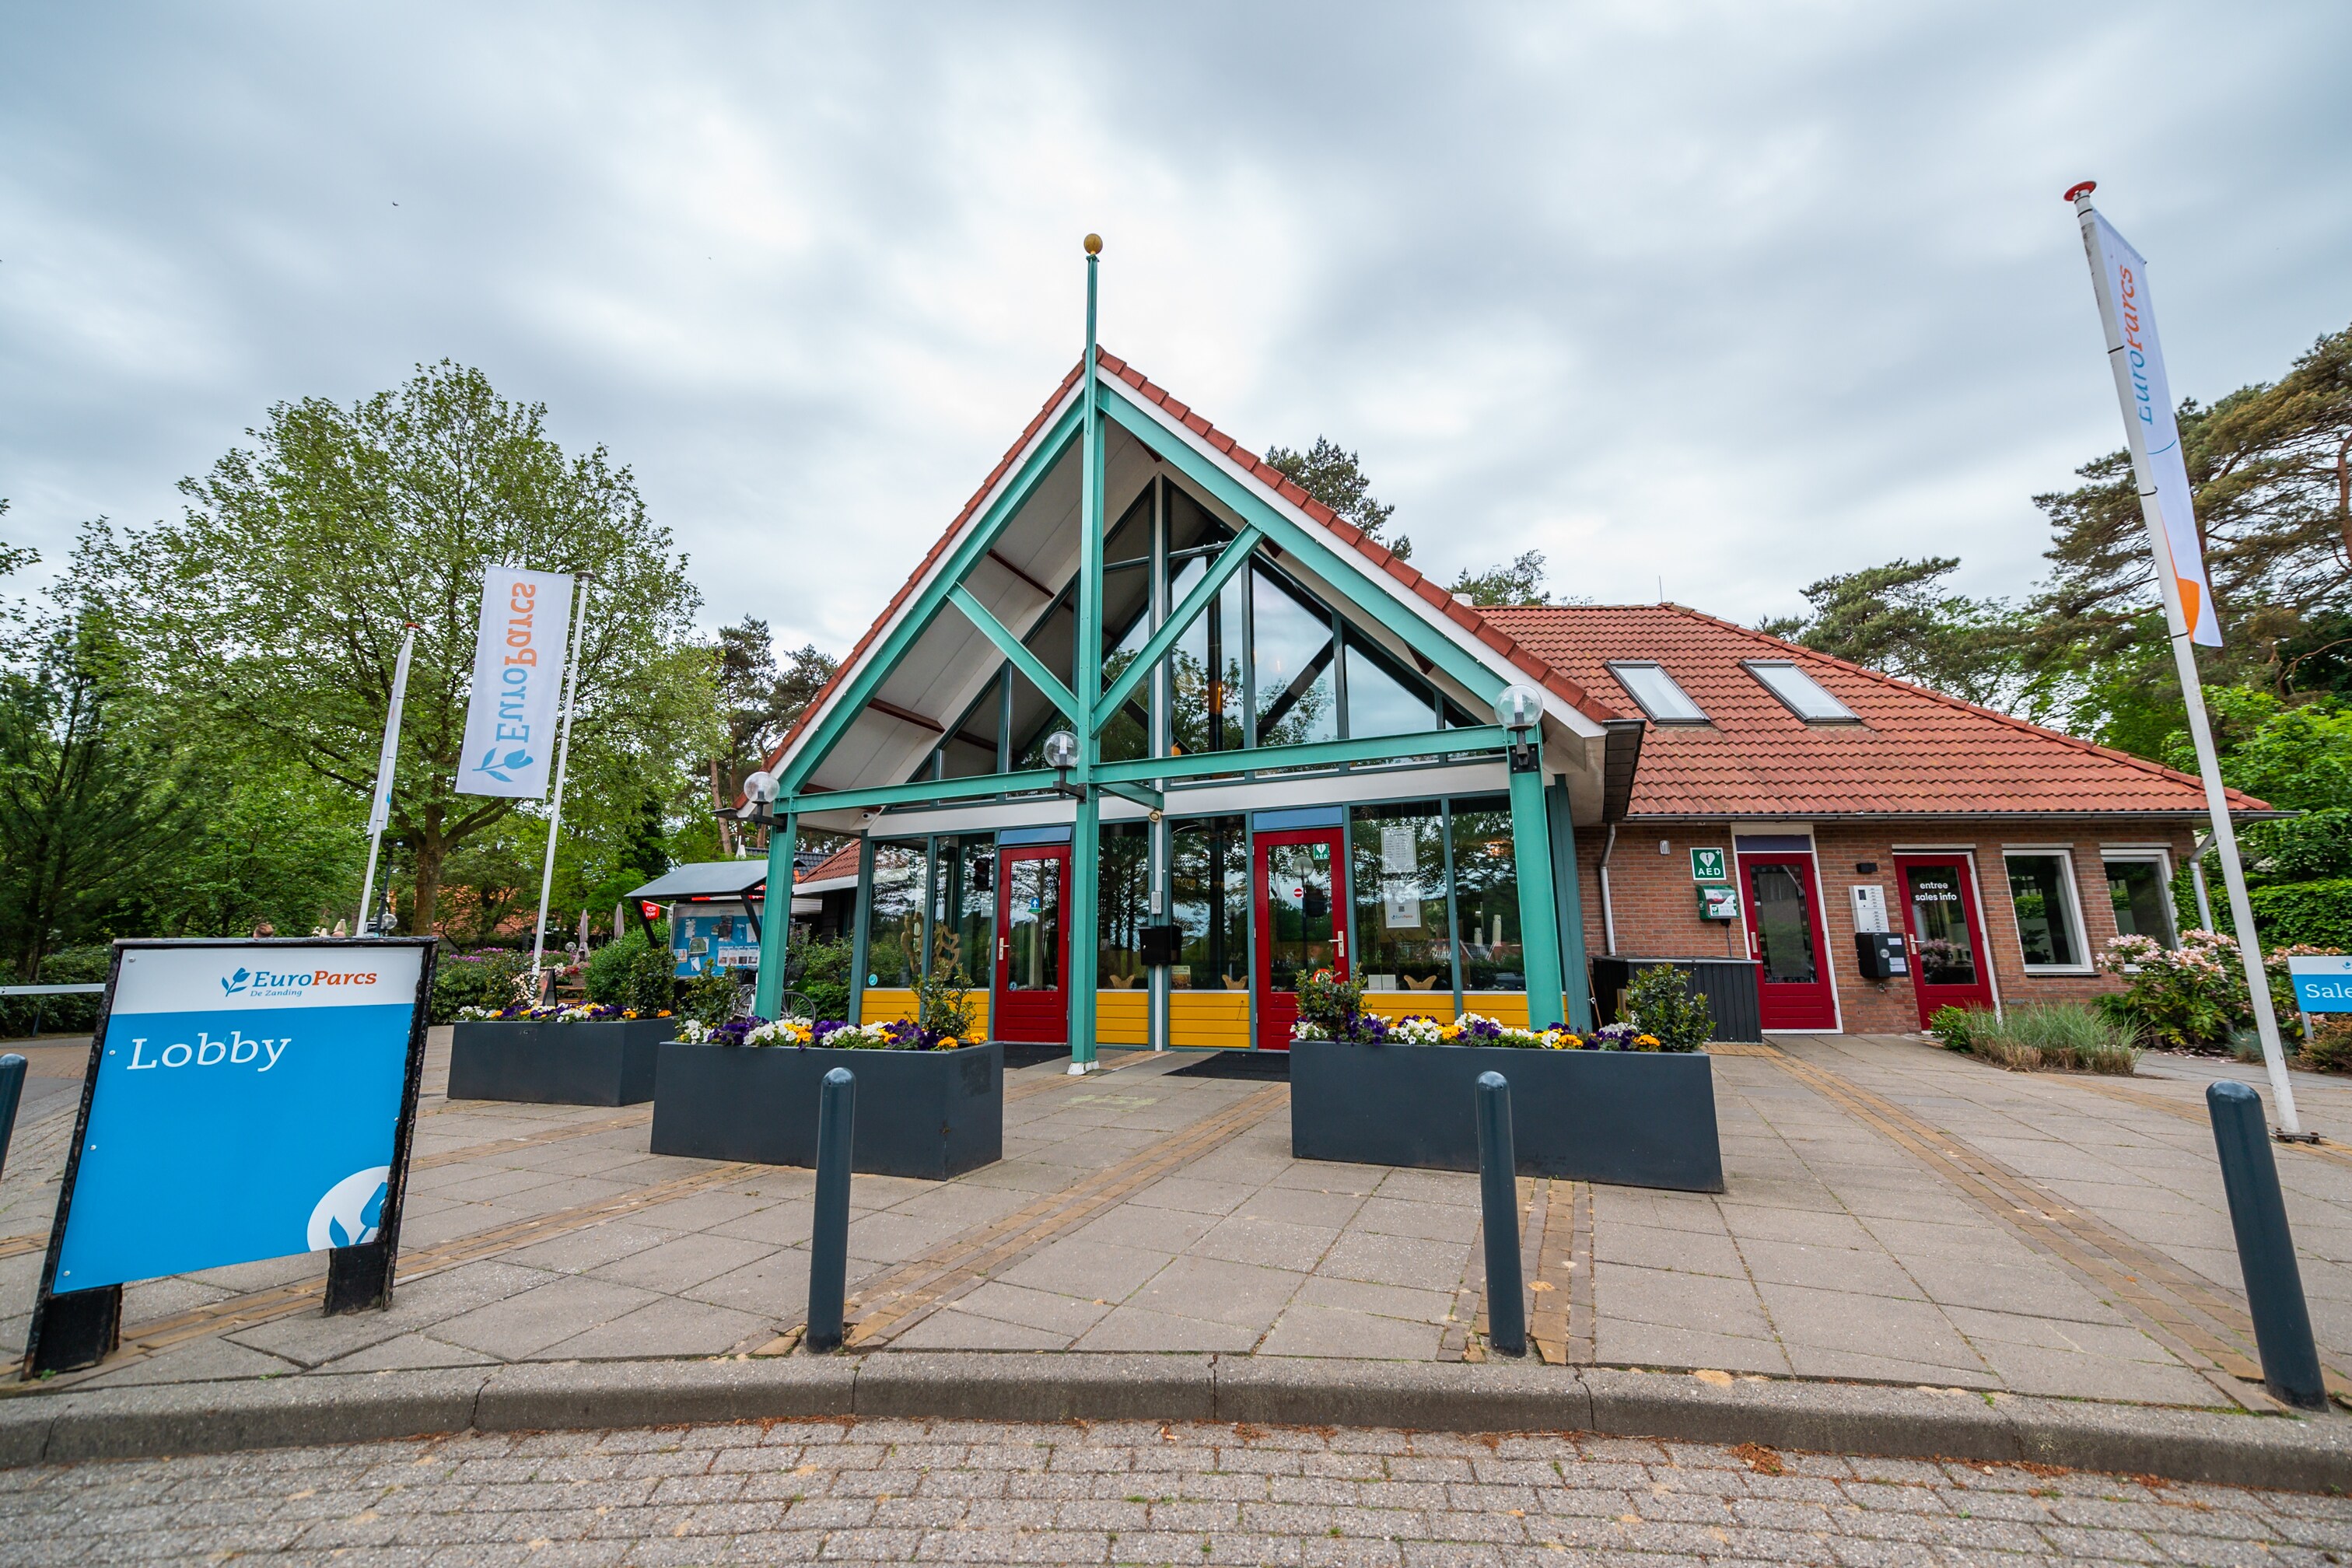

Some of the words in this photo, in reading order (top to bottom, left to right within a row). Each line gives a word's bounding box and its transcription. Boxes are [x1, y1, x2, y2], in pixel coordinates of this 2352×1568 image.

[1698, 867, 1721, 876] AED
[1915, 892, 1938, 901] sales
[1939, 892, 1957, 901] info
[252, 971, 377, 987] EuroParcs
[126, 1031, 292, 1073] Lobby
